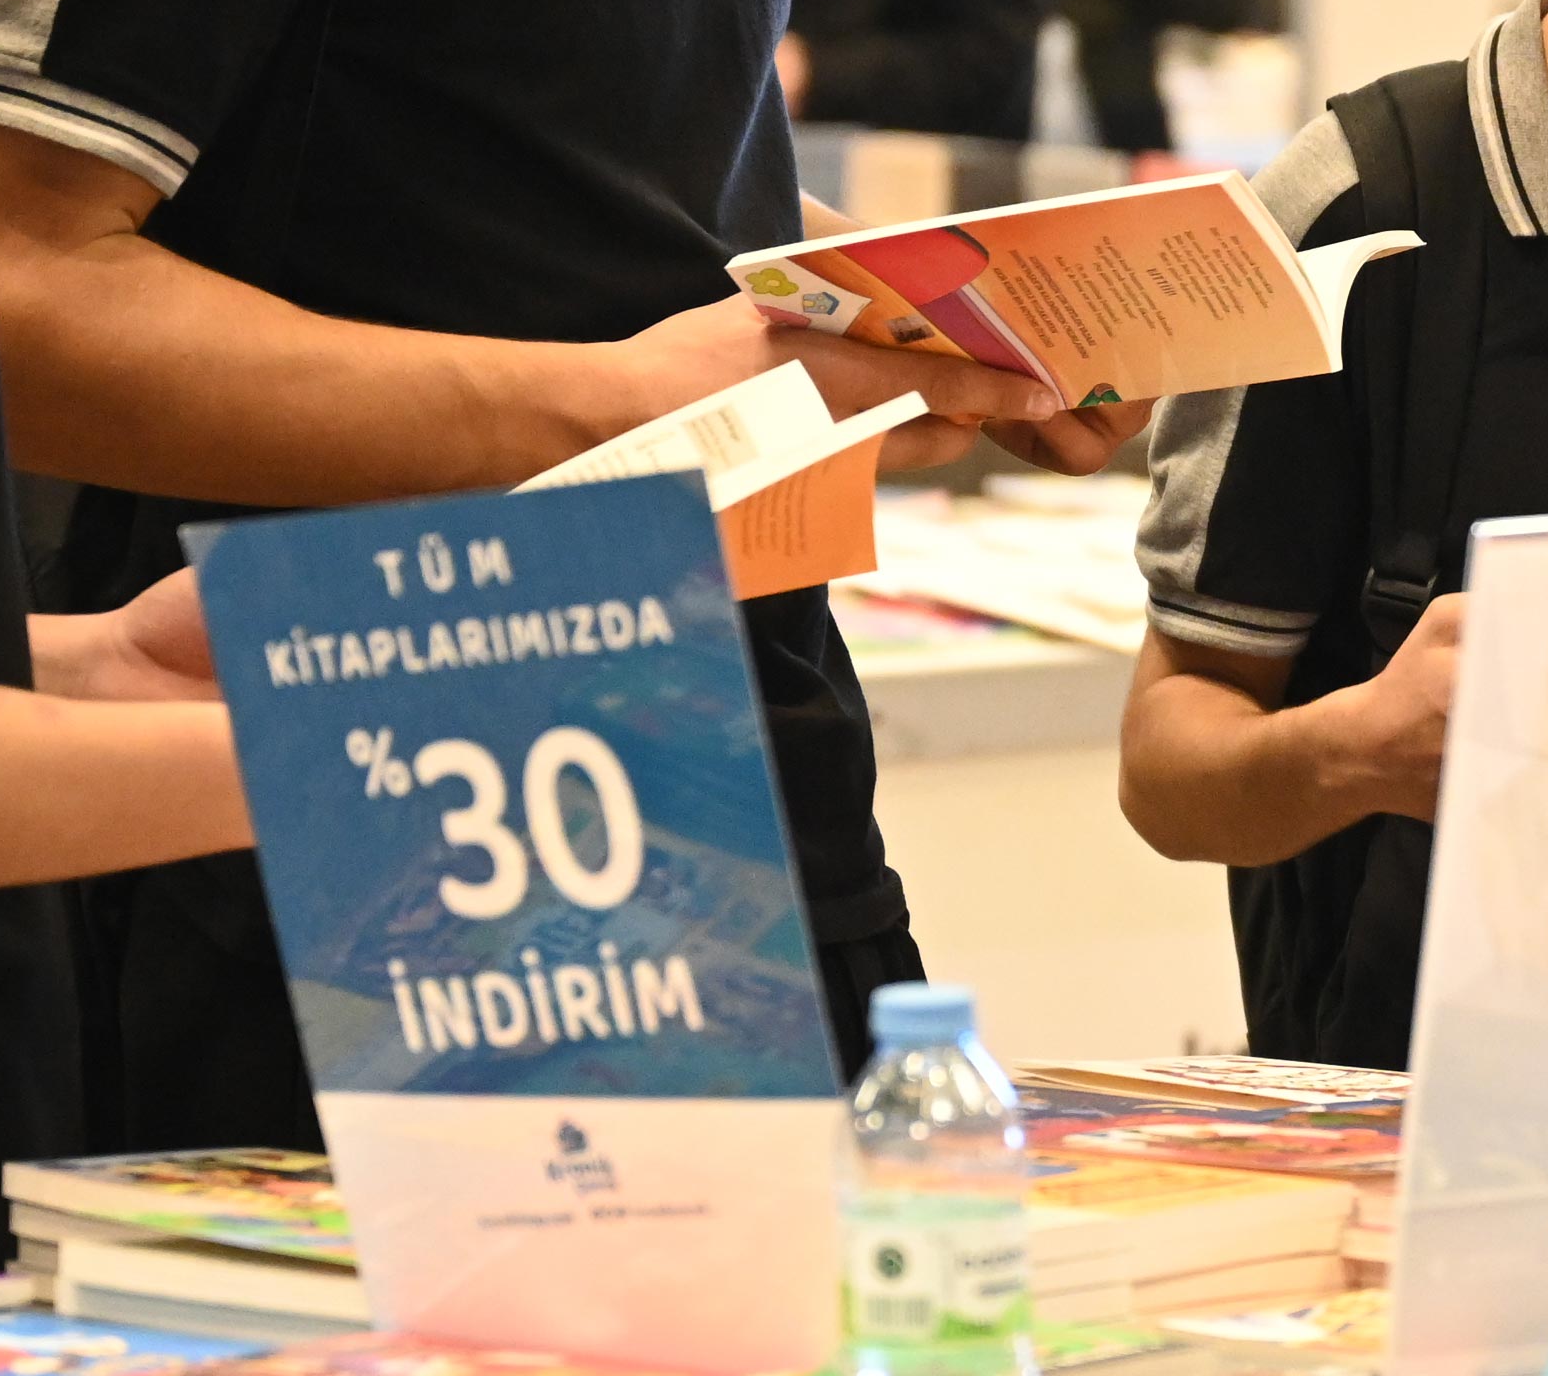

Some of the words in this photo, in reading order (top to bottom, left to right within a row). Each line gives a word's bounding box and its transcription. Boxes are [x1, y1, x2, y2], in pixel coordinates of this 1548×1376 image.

[373, 532, 513, 599] TÜM
[264, 596, 675, 689] KİTAPLARIMIZDA
[345, 724, 644, 922] %30
[387, 941, 706, 1054] İNDİRİM
